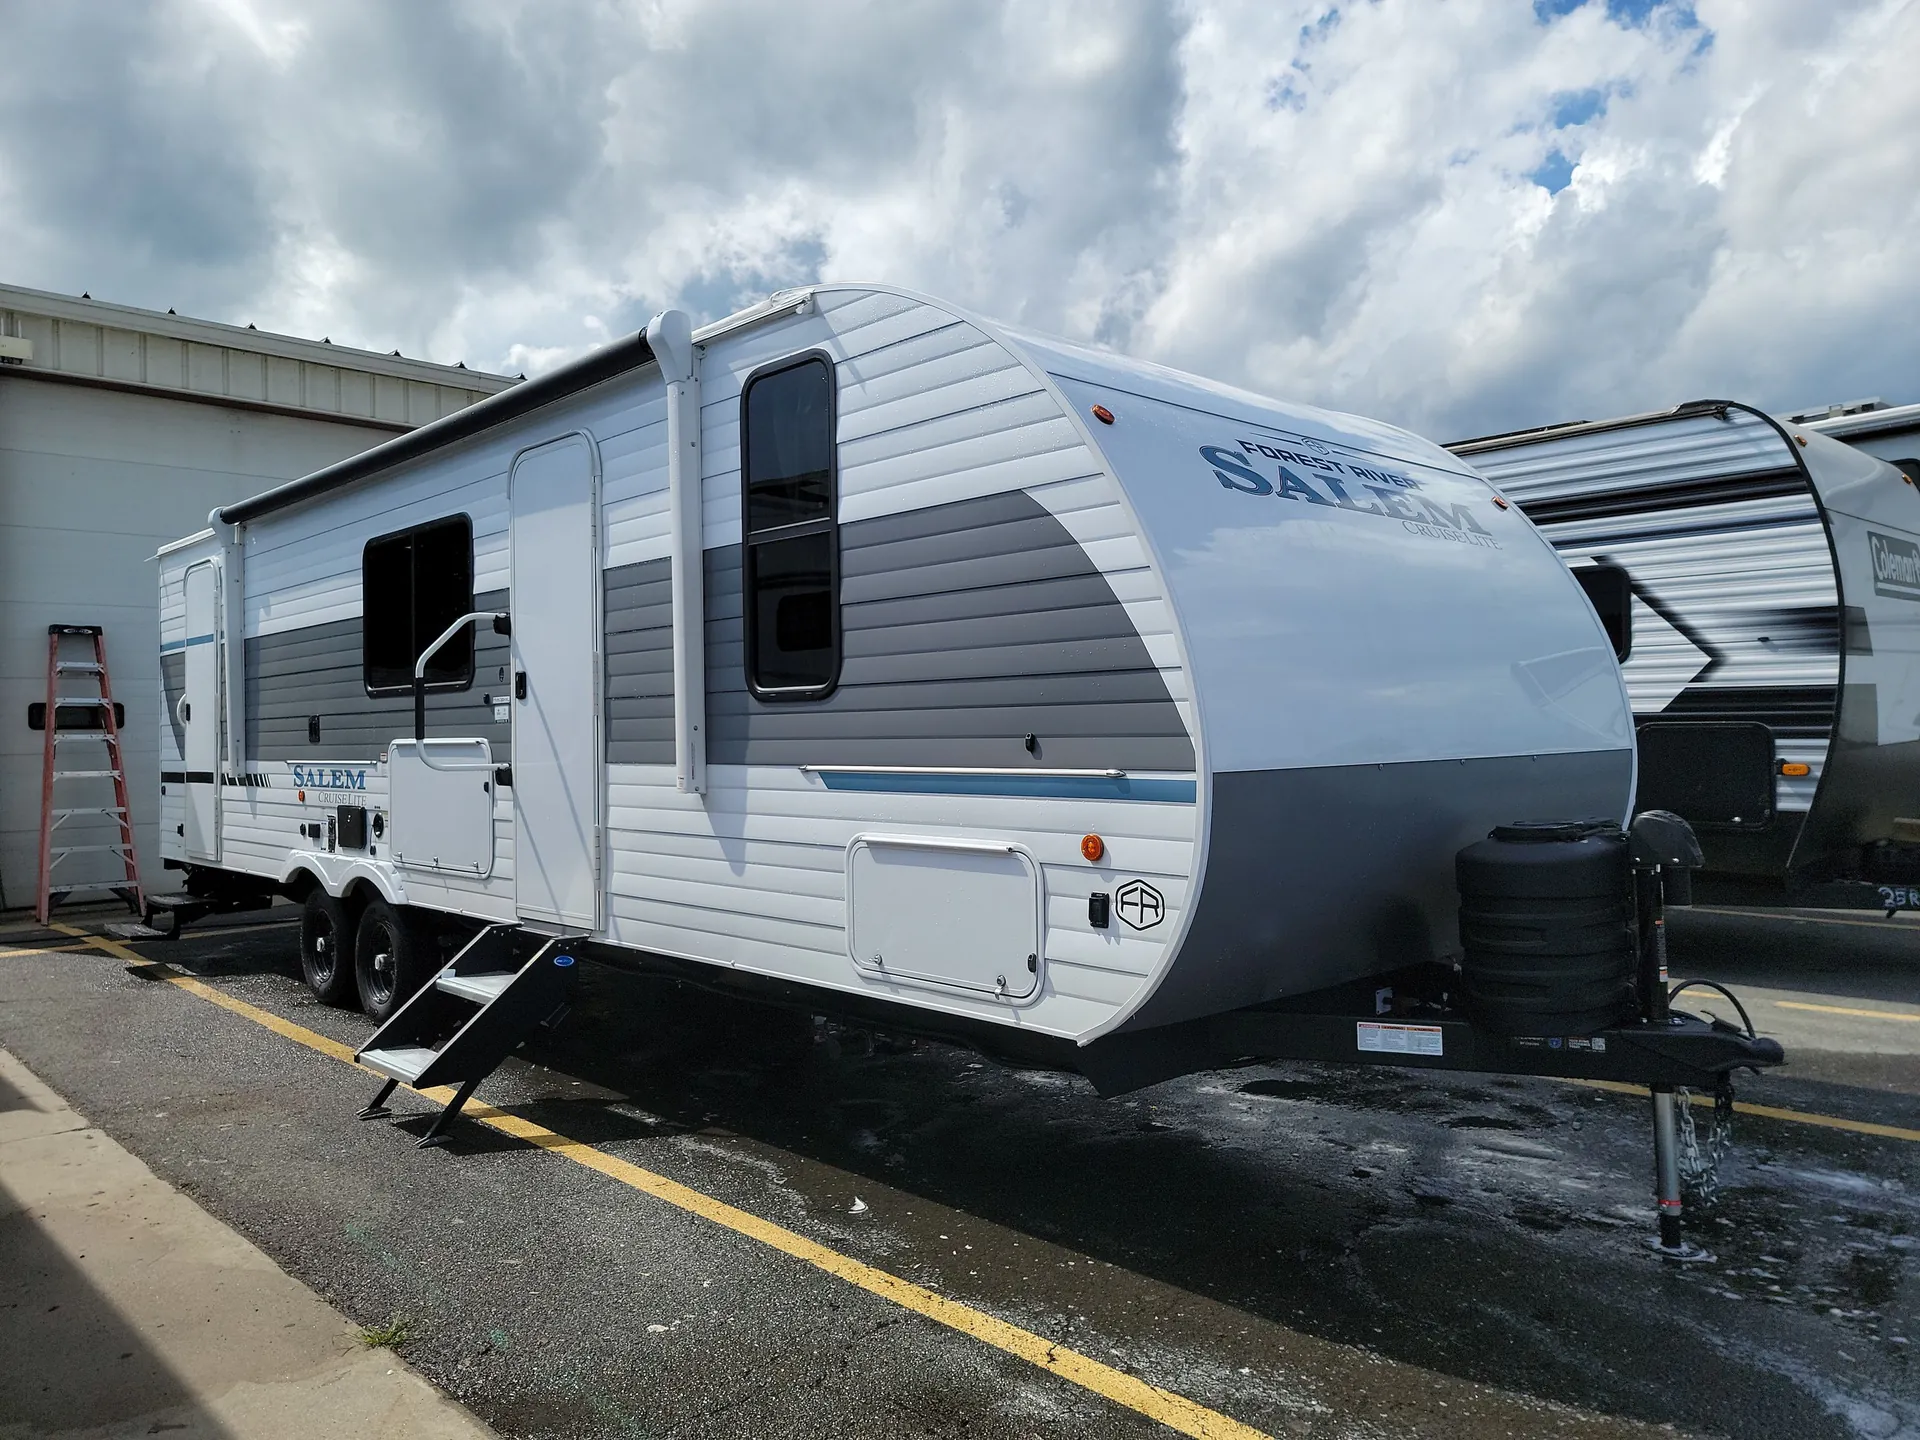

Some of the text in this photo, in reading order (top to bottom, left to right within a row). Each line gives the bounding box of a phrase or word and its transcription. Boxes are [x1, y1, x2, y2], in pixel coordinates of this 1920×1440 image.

[1235, 438, 1422, 491] FOREST RIVER
[1198, 444, 1494, 537] SALEM
[1871, 535, 1917, 584] Coleman
[293, 764, 367, 790] SALEM
